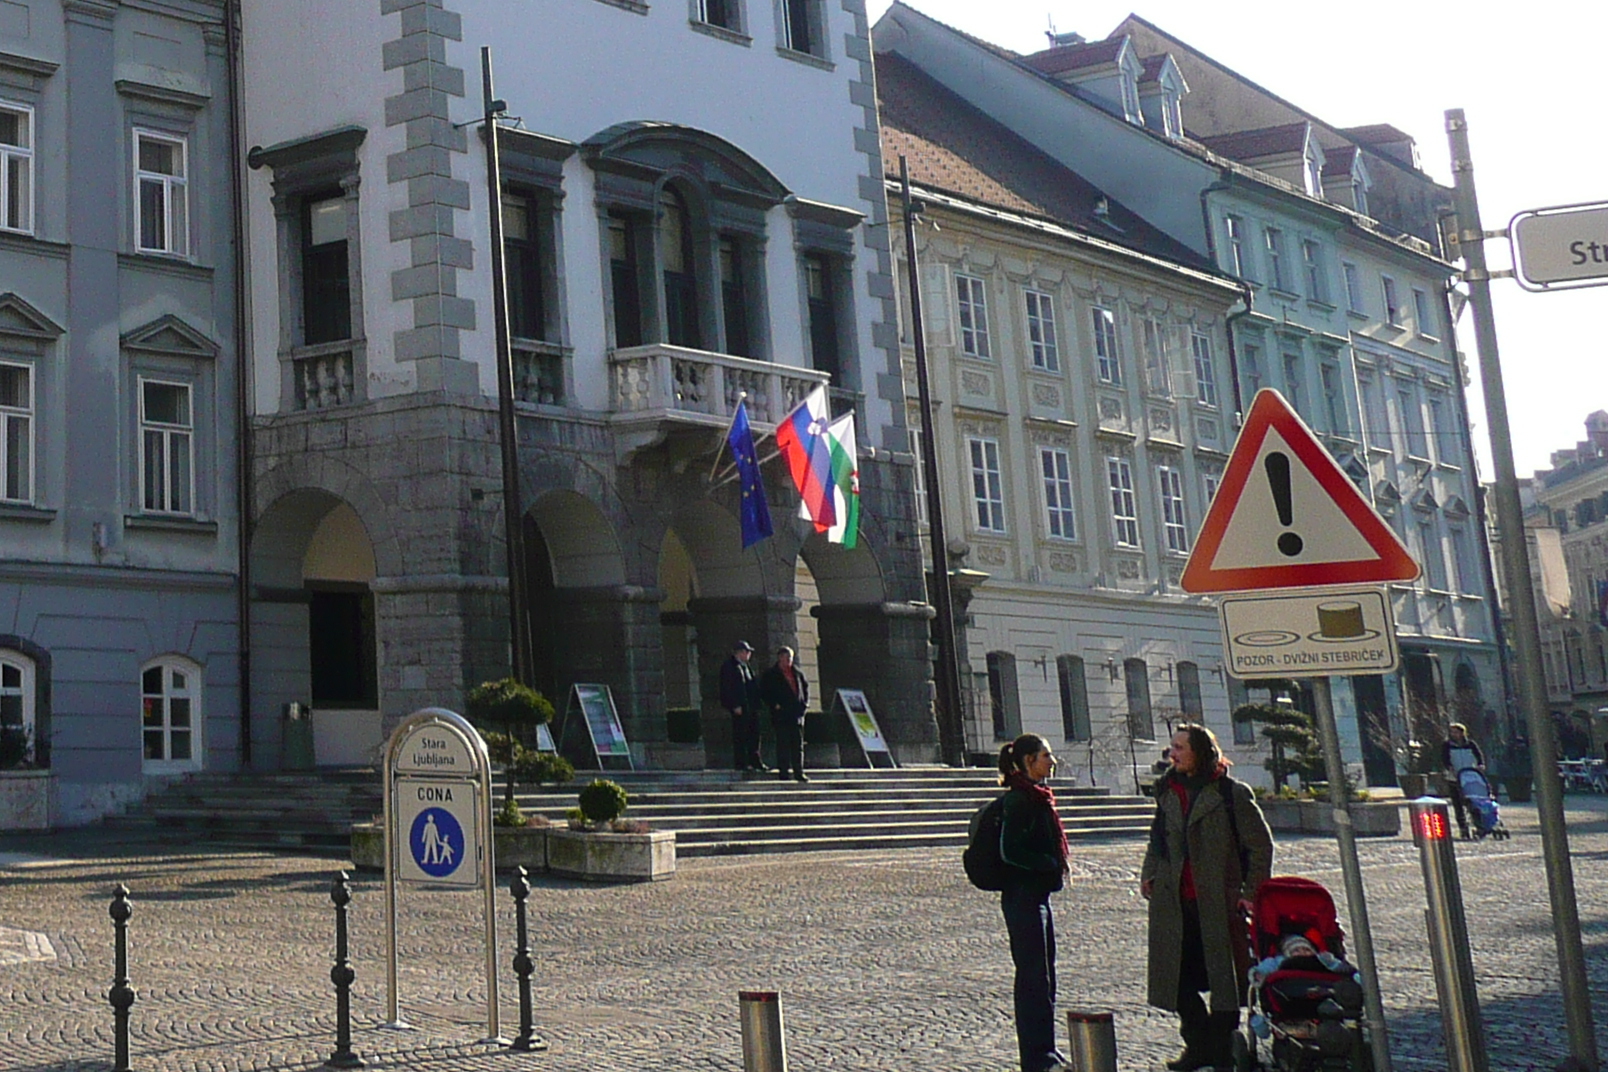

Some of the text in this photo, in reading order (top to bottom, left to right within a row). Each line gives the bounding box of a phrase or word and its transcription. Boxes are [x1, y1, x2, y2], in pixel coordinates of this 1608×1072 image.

[1237, 654, 1274, 666] POZOR
[1283, 651, 1319, 666] DVIŽNI
[1322, 648, 1385, 663] STEBRIČEK
[421, 738, 446, 748] Stara
[413, 753, 455, 767] Ljubljana
[417, 787, 453, 802] CONA
